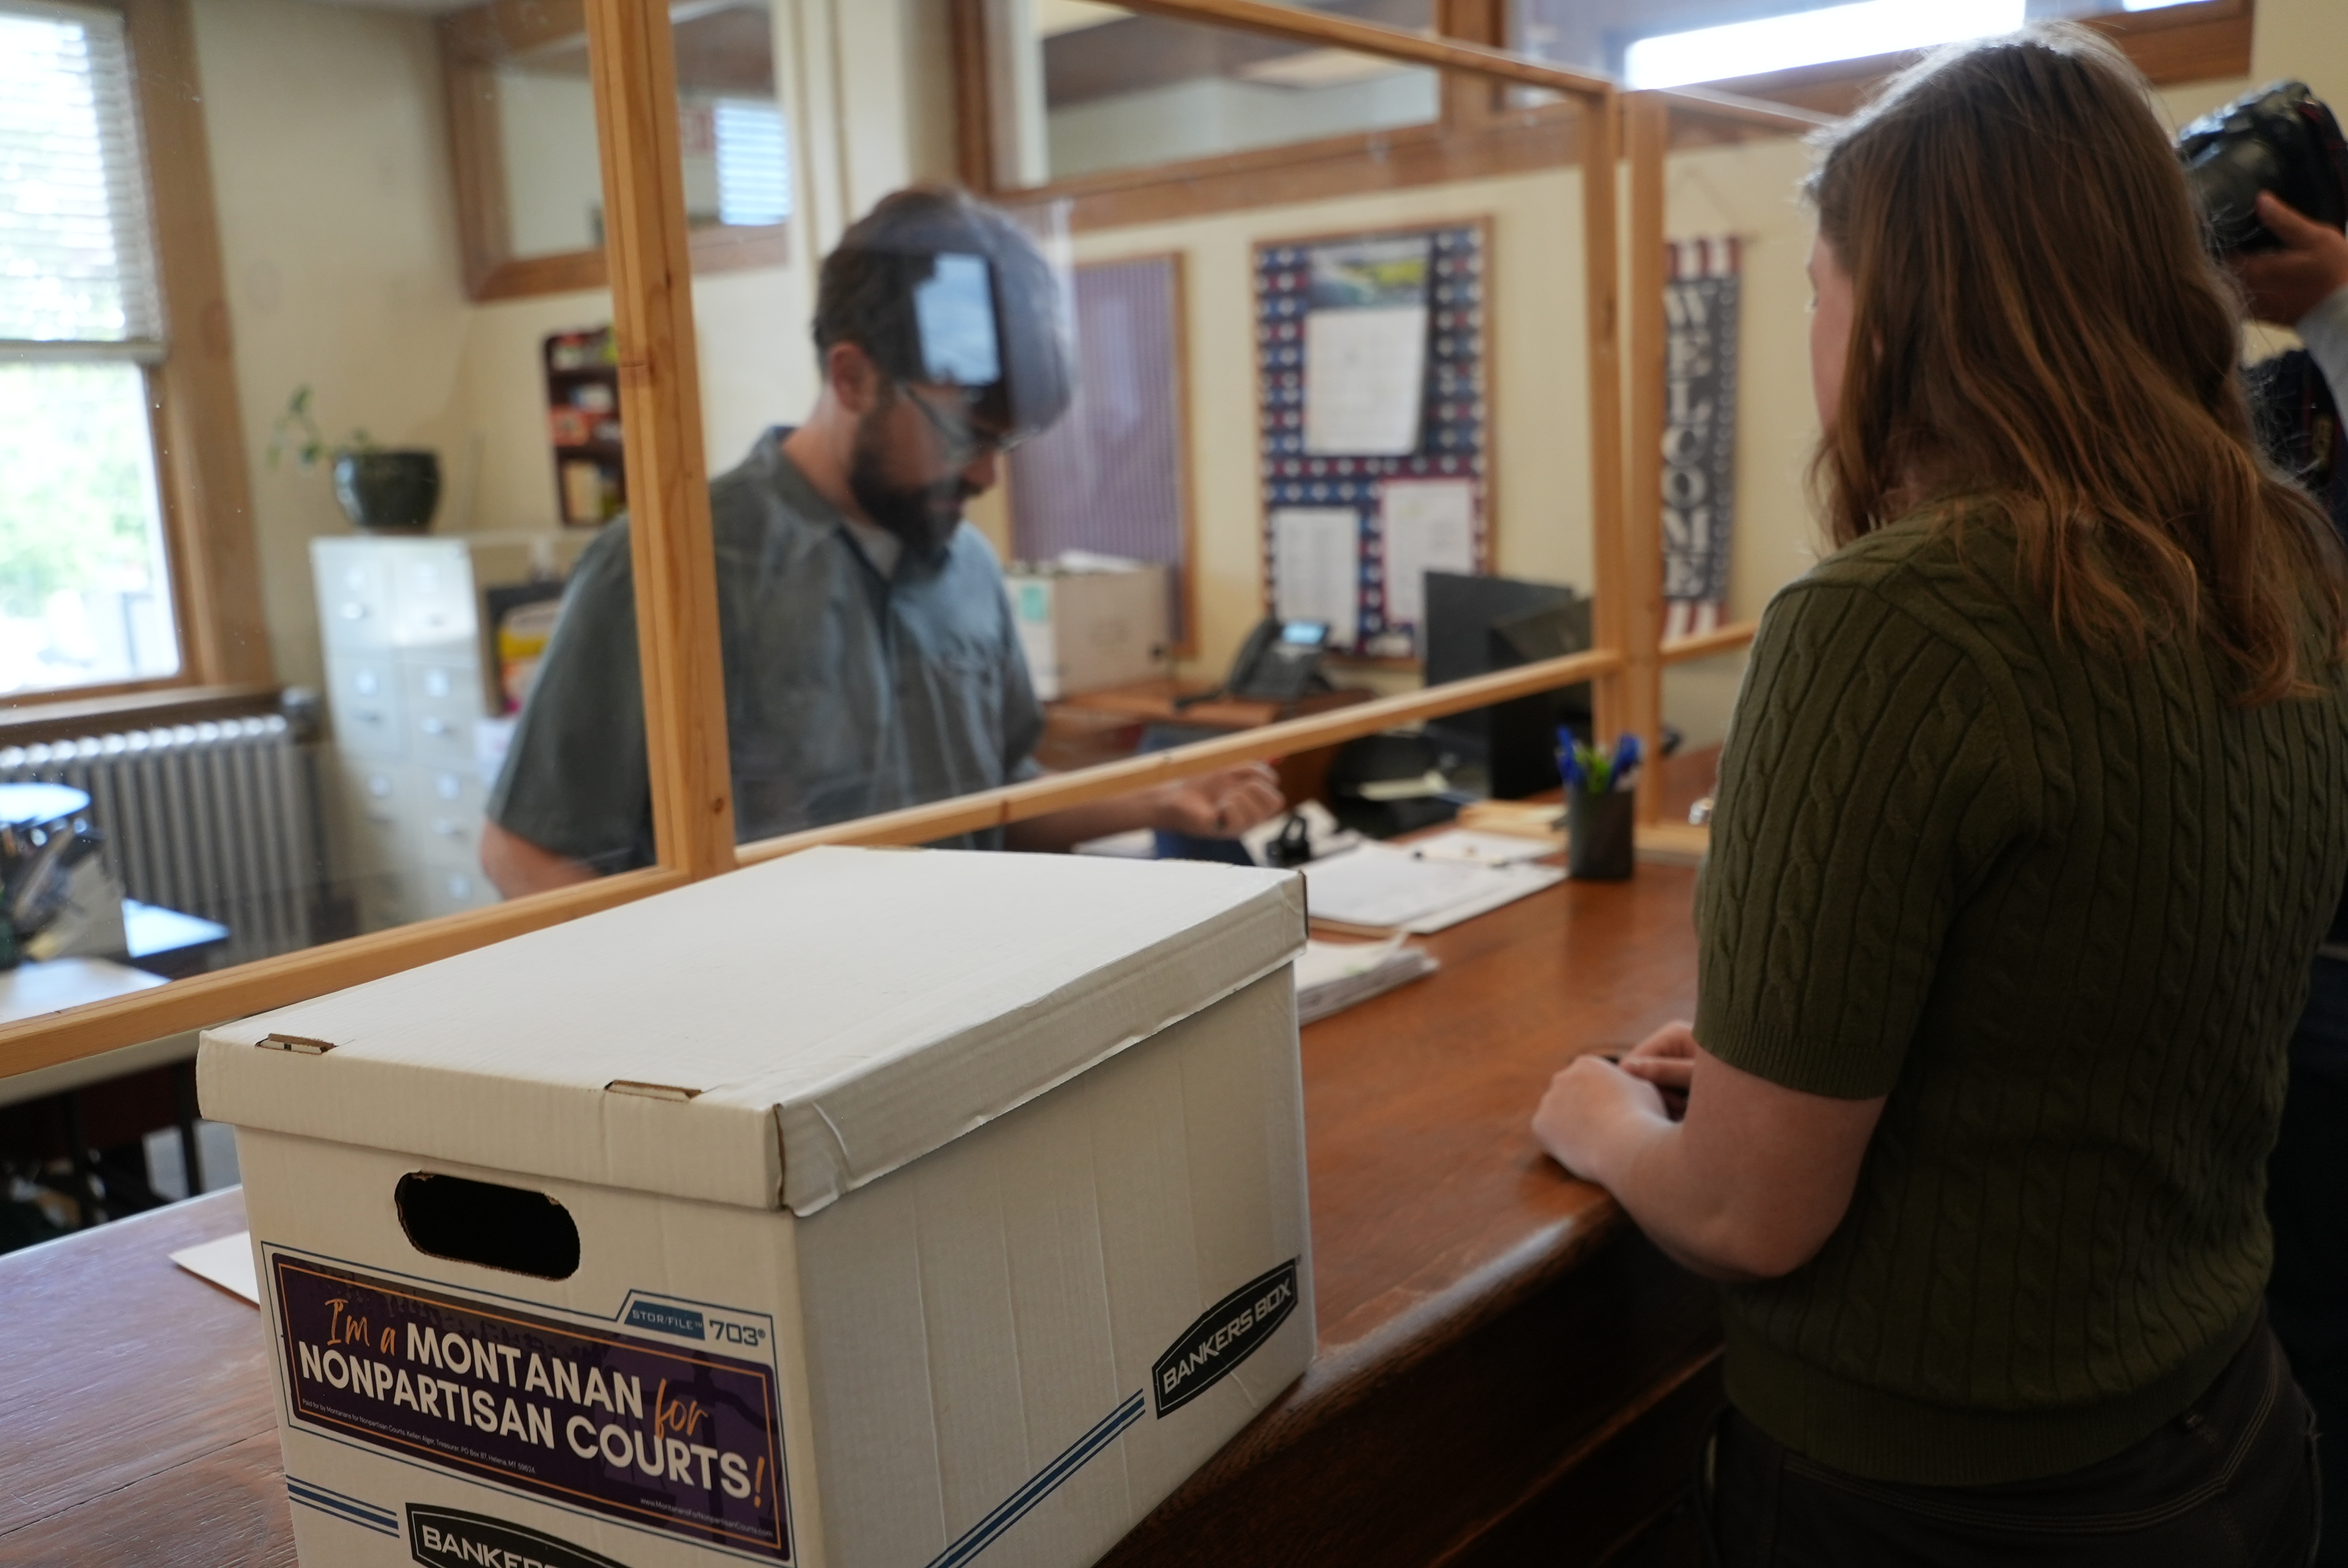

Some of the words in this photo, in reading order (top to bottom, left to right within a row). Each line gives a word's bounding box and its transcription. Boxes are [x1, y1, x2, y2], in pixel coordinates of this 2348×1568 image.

[325, 1298, 370, 1348] I'm
[380, 1327, 395, 1356] a
[408, 1322, 643, 1420] MONTANAN
[655, 1379, 708, 1440] for
[1163, 1308, 1253, 1395] BANKERS
[1254, 1277, 1291, 1322] BOX
[298, 1340, 555, 1450] NONPARTISAN
[566, 1415, 765, 1509] COURTS!
[302, 1398, 312, 1407] Paid
[320, 1404, 326, 1412] by
[327, 1406, 352, 1420] Montanans
[359, 1416, 388, 1431] Nonpartisan
[461, 1446, 469, 1455] PO
[470, 1448, 480, 1458] Box
[422, 1524, 560, 1568] BANKE
